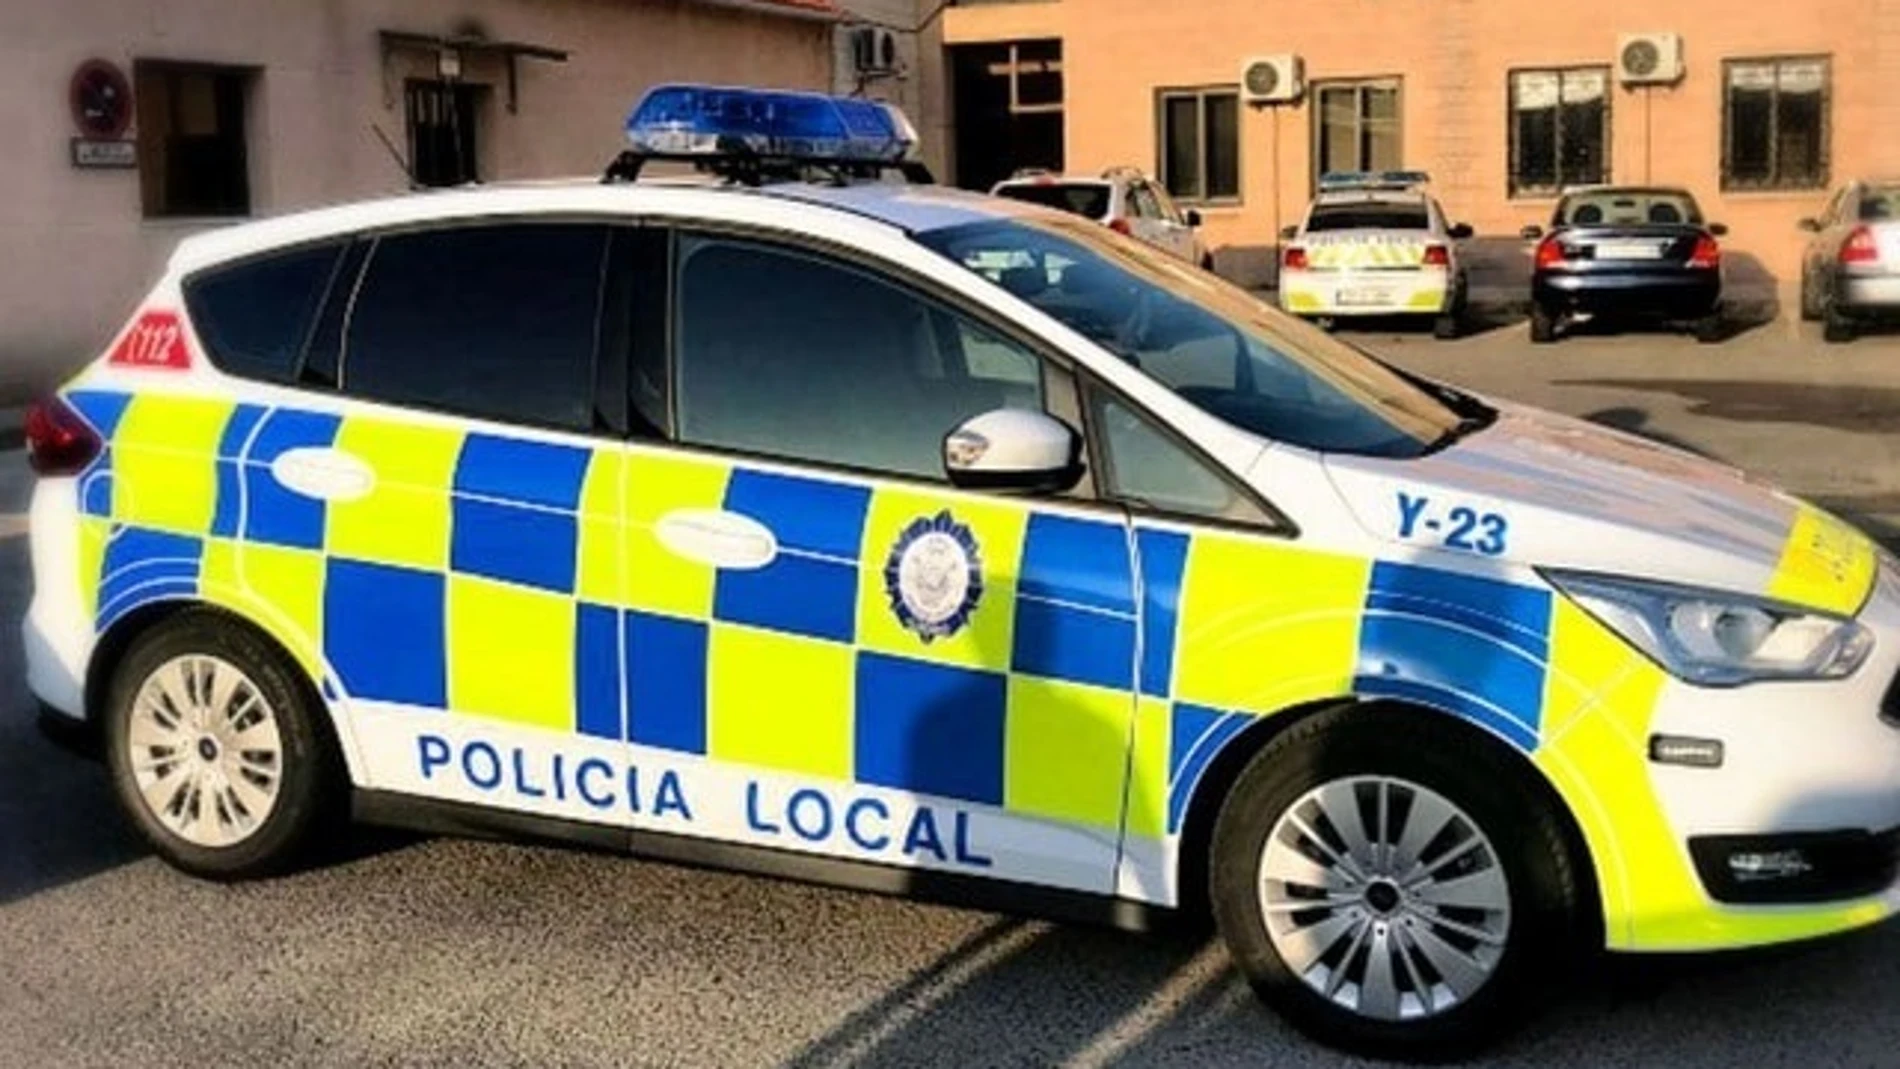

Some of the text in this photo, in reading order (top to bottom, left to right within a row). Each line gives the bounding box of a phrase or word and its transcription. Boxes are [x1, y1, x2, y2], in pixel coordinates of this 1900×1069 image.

[138, 322, 177, 361] 112
[1397, 491, 1507, 556] Y-23
[417, 734, 993, 868] POLICIA LOCAL
